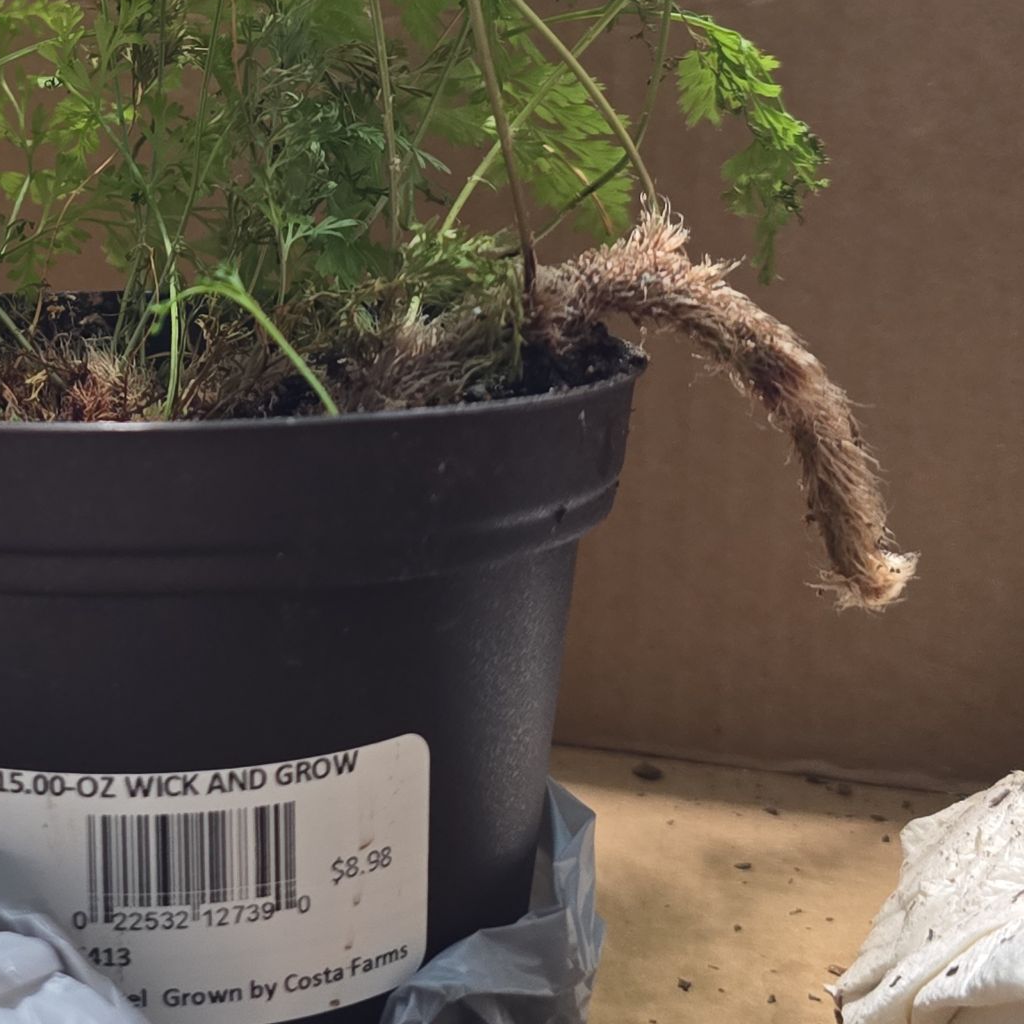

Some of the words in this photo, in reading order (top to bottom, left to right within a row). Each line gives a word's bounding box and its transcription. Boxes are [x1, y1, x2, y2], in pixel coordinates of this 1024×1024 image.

[125, 774, 200, 798] WICK
[206, 768, 268, 795] AND
[275, 750, 360, 787] GROW
[331, 845, 393, 886] $8.98
[72, 910, 88, 931] 0
[112, 910, 190, 932] 22532
[202, 901, 275, 927] 12739
[297, 894, 312, 914] 0
[79, 946, 132, 968] 413
[162, 986, 244, 1008] Grown
[249, 980, 278, 1002] by
[284, 966, 345, 994] Costa
[350, 944, 409, 977] Farms
